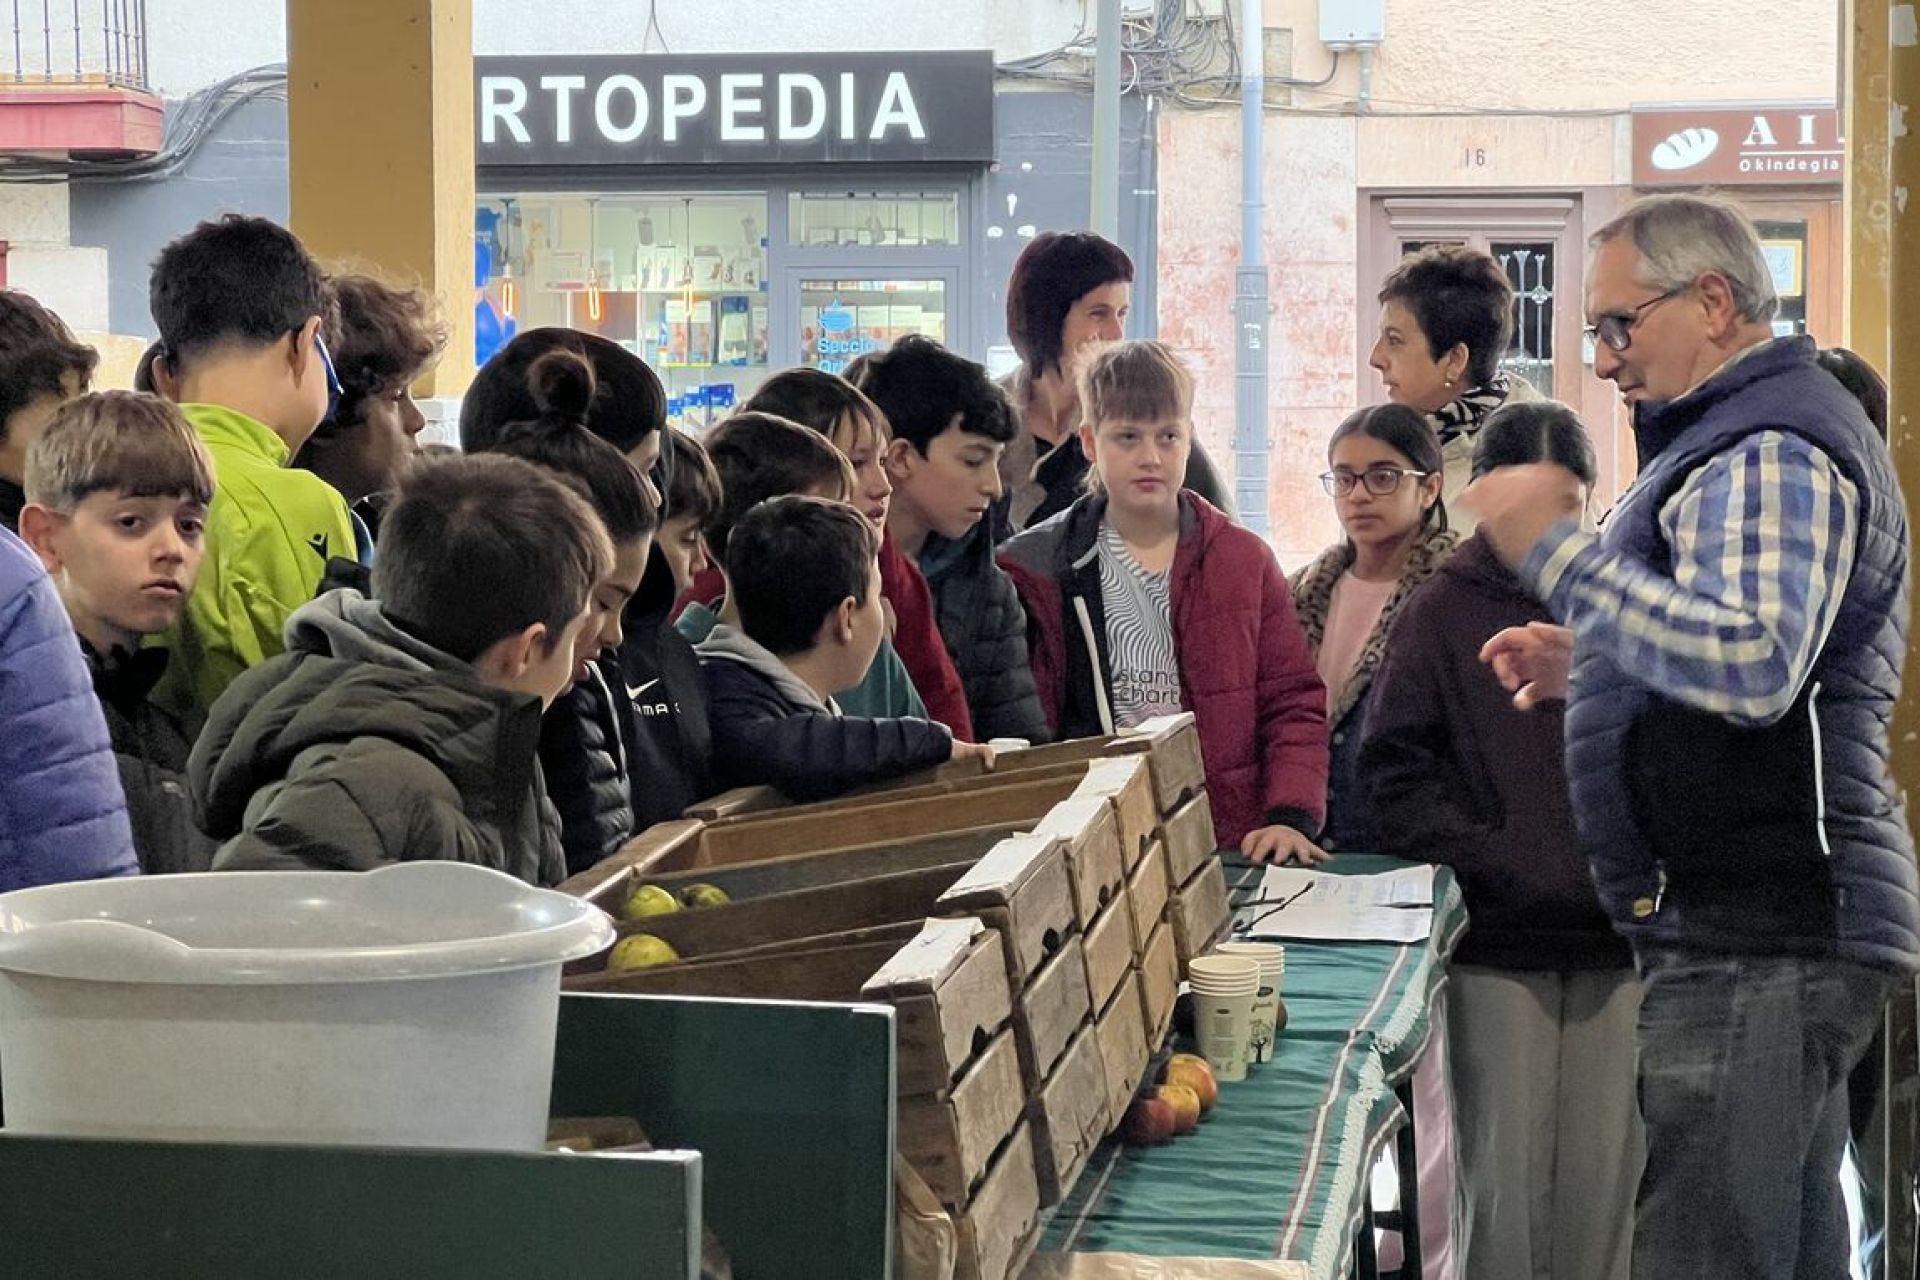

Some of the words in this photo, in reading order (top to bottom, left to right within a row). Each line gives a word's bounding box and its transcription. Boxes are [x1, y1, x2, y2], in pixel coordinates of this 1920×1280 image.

[480, 71, 926, 144] RTOPEDIA
[1741, 114, 1845, 146] AI
[1465, 148, 1486, 168] 16
[1739, 157, 1840, 174] Okindegia
